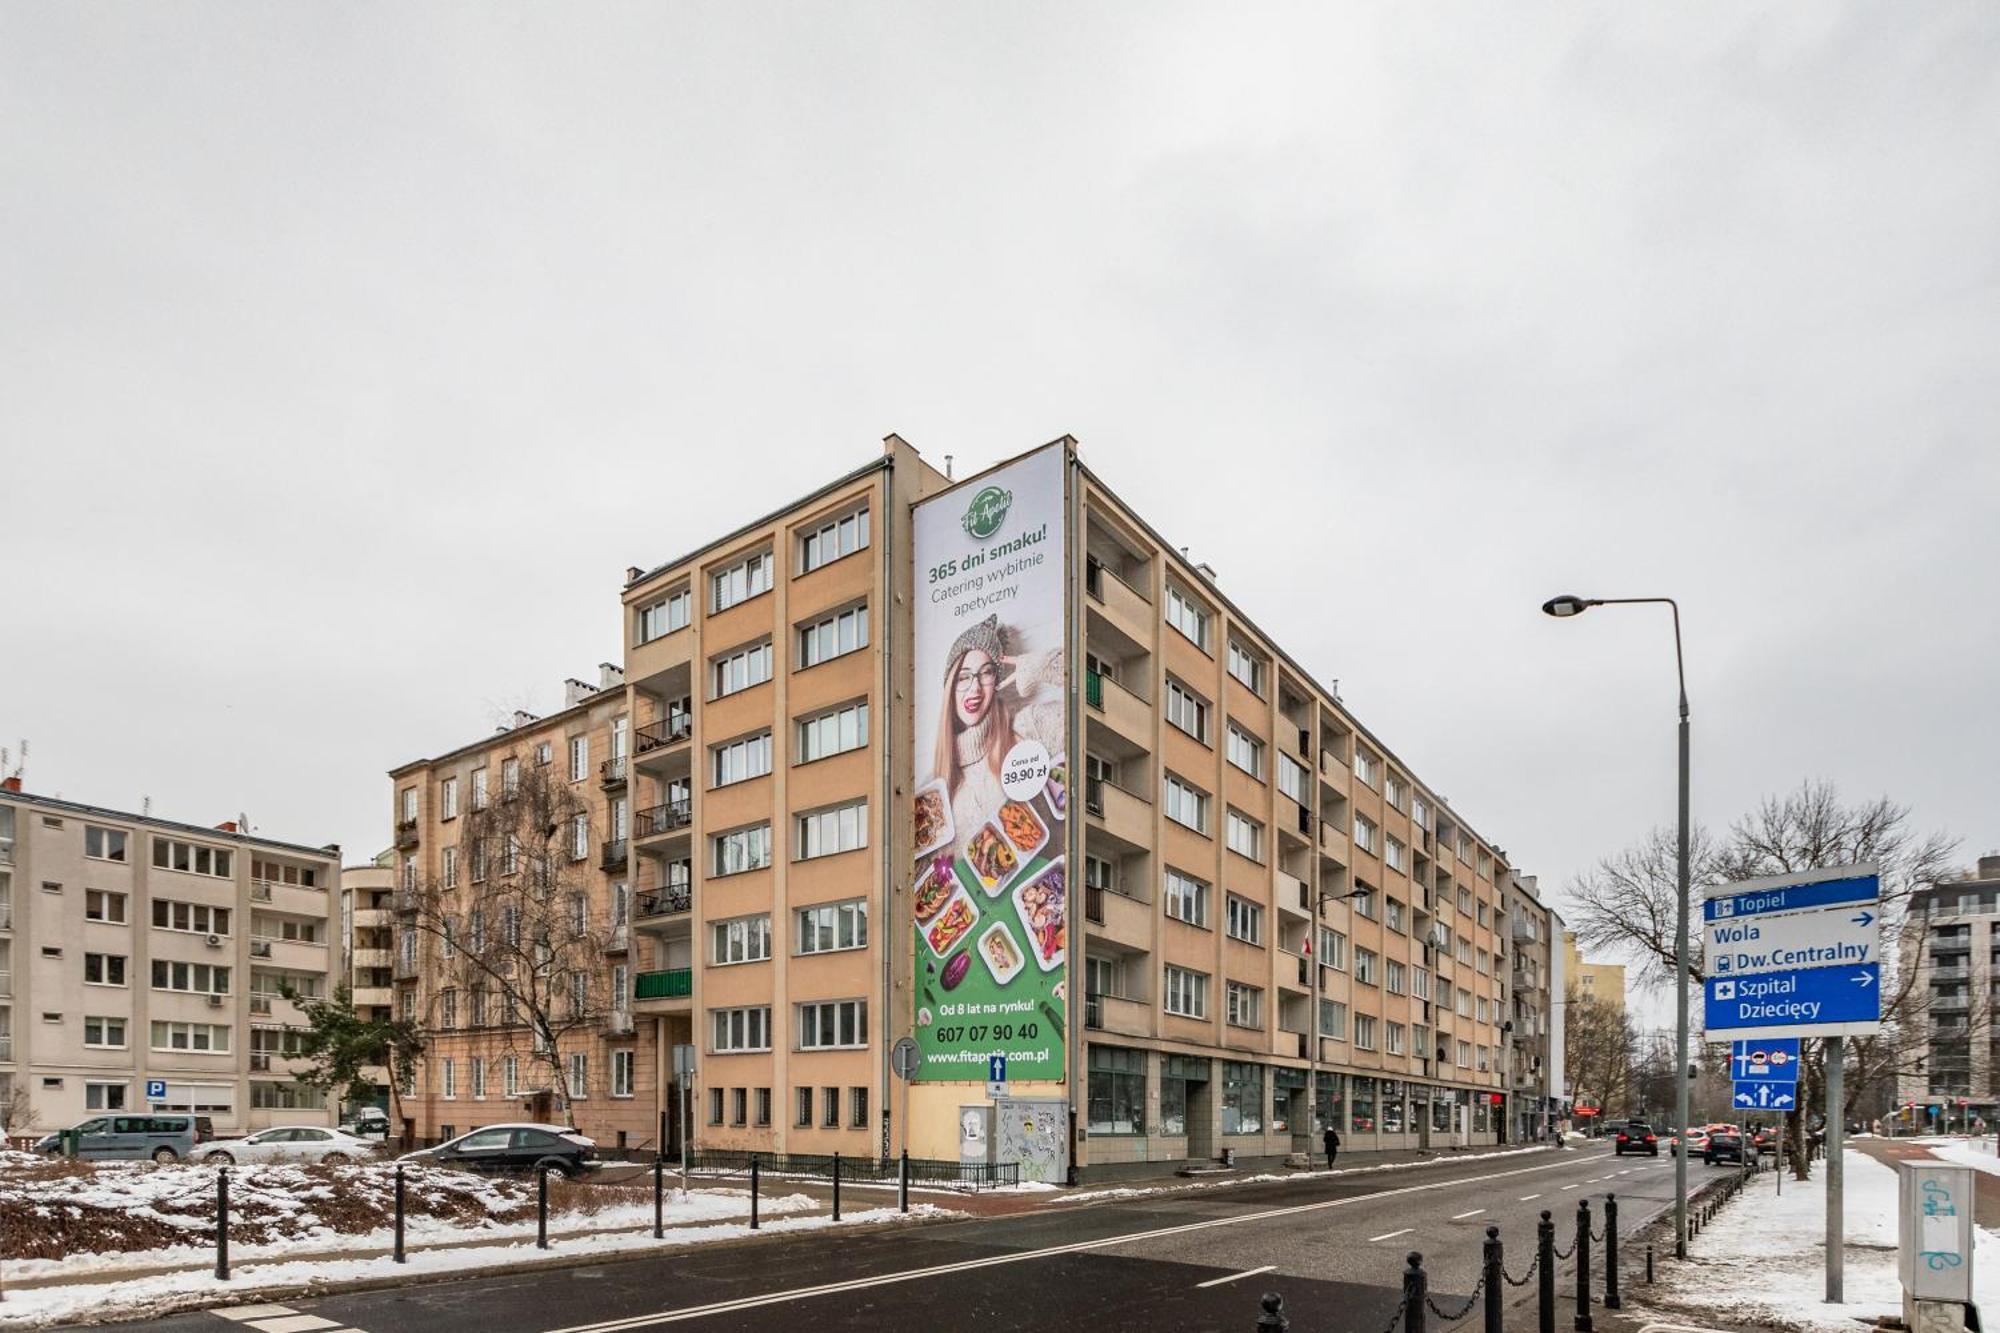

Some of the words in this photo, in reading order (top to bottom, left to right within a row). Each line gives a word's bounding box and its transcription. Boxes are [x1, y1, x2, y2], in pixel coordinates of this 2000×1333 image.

[928, 560, 957, 584] 365
[961, 548, 985, 571] dni
[990, 524, 1047, 561] smaku!
[931, 577, 984, 603] Catering
[987, 553, 1044, 583] wybitnie
[954, 584, 1019, 617] apetyczny
[1004, 768, 1034, 784] 39,90
[1037, 764, 1047, 777] zł
[1739, 893, 1785, 912] Topiel
[1714, 925, 1760, 944] Wola
[1738, 942, 1869, 970] Dw.Centralny
[1739, 976, 1796, 999] Szpital
[940, 1004, 953, 1016] Od
[957, 1003, 965, 1014] 8
[967, 1002, 980, 1014] lat
[983, 1003, 997, 1013] na
[999, 999, 1034, 1013] rynku!
[1739, 1000, 1821, 1019] Dziecięcy
[936, 1026, 965, 1043] 607
[969, 1026, 988, 1041] 07
[993, 1024, 1013, 1040] 90
[1018, 1023, 1038, 1040] 40
[151, 1082, 163, 1095] P
